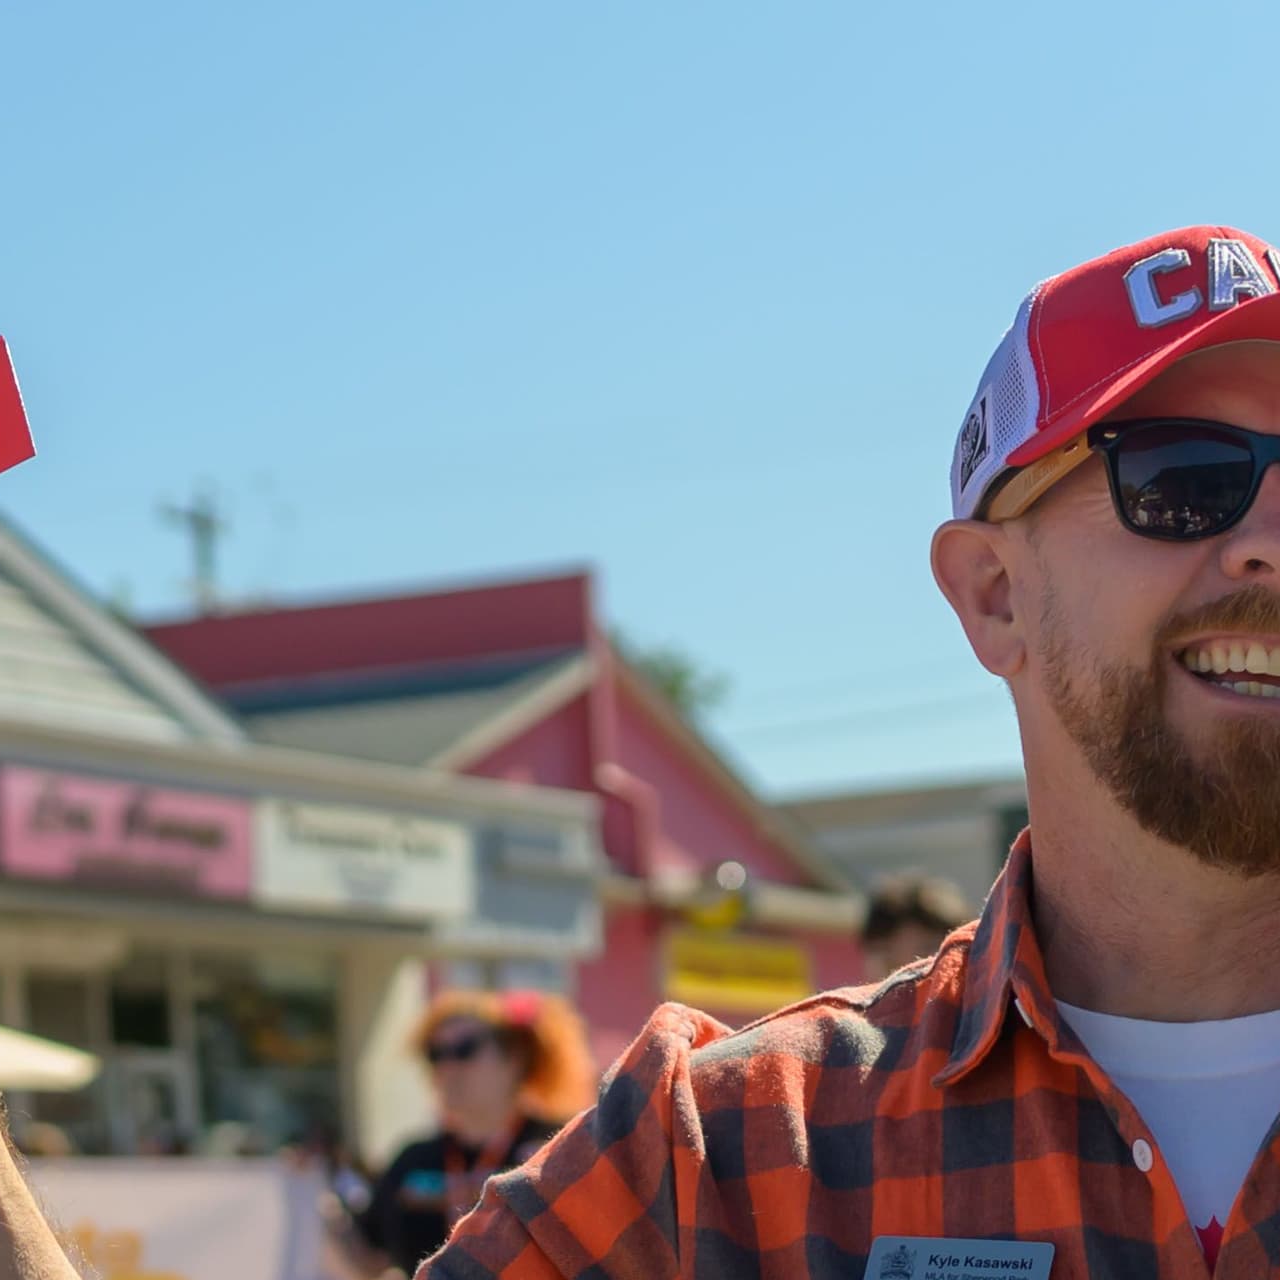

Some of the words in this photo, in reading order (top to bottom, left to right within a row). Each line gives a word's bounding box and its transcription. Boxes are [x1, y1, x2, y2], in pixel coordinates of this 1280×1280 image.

[928, 1254, 960, 1270] Kyle
[963, 1255, 1034, 1271] Kasawski
[924, 1272, 946, 1280] MLA
[947, 1272, 960, 1280] for
